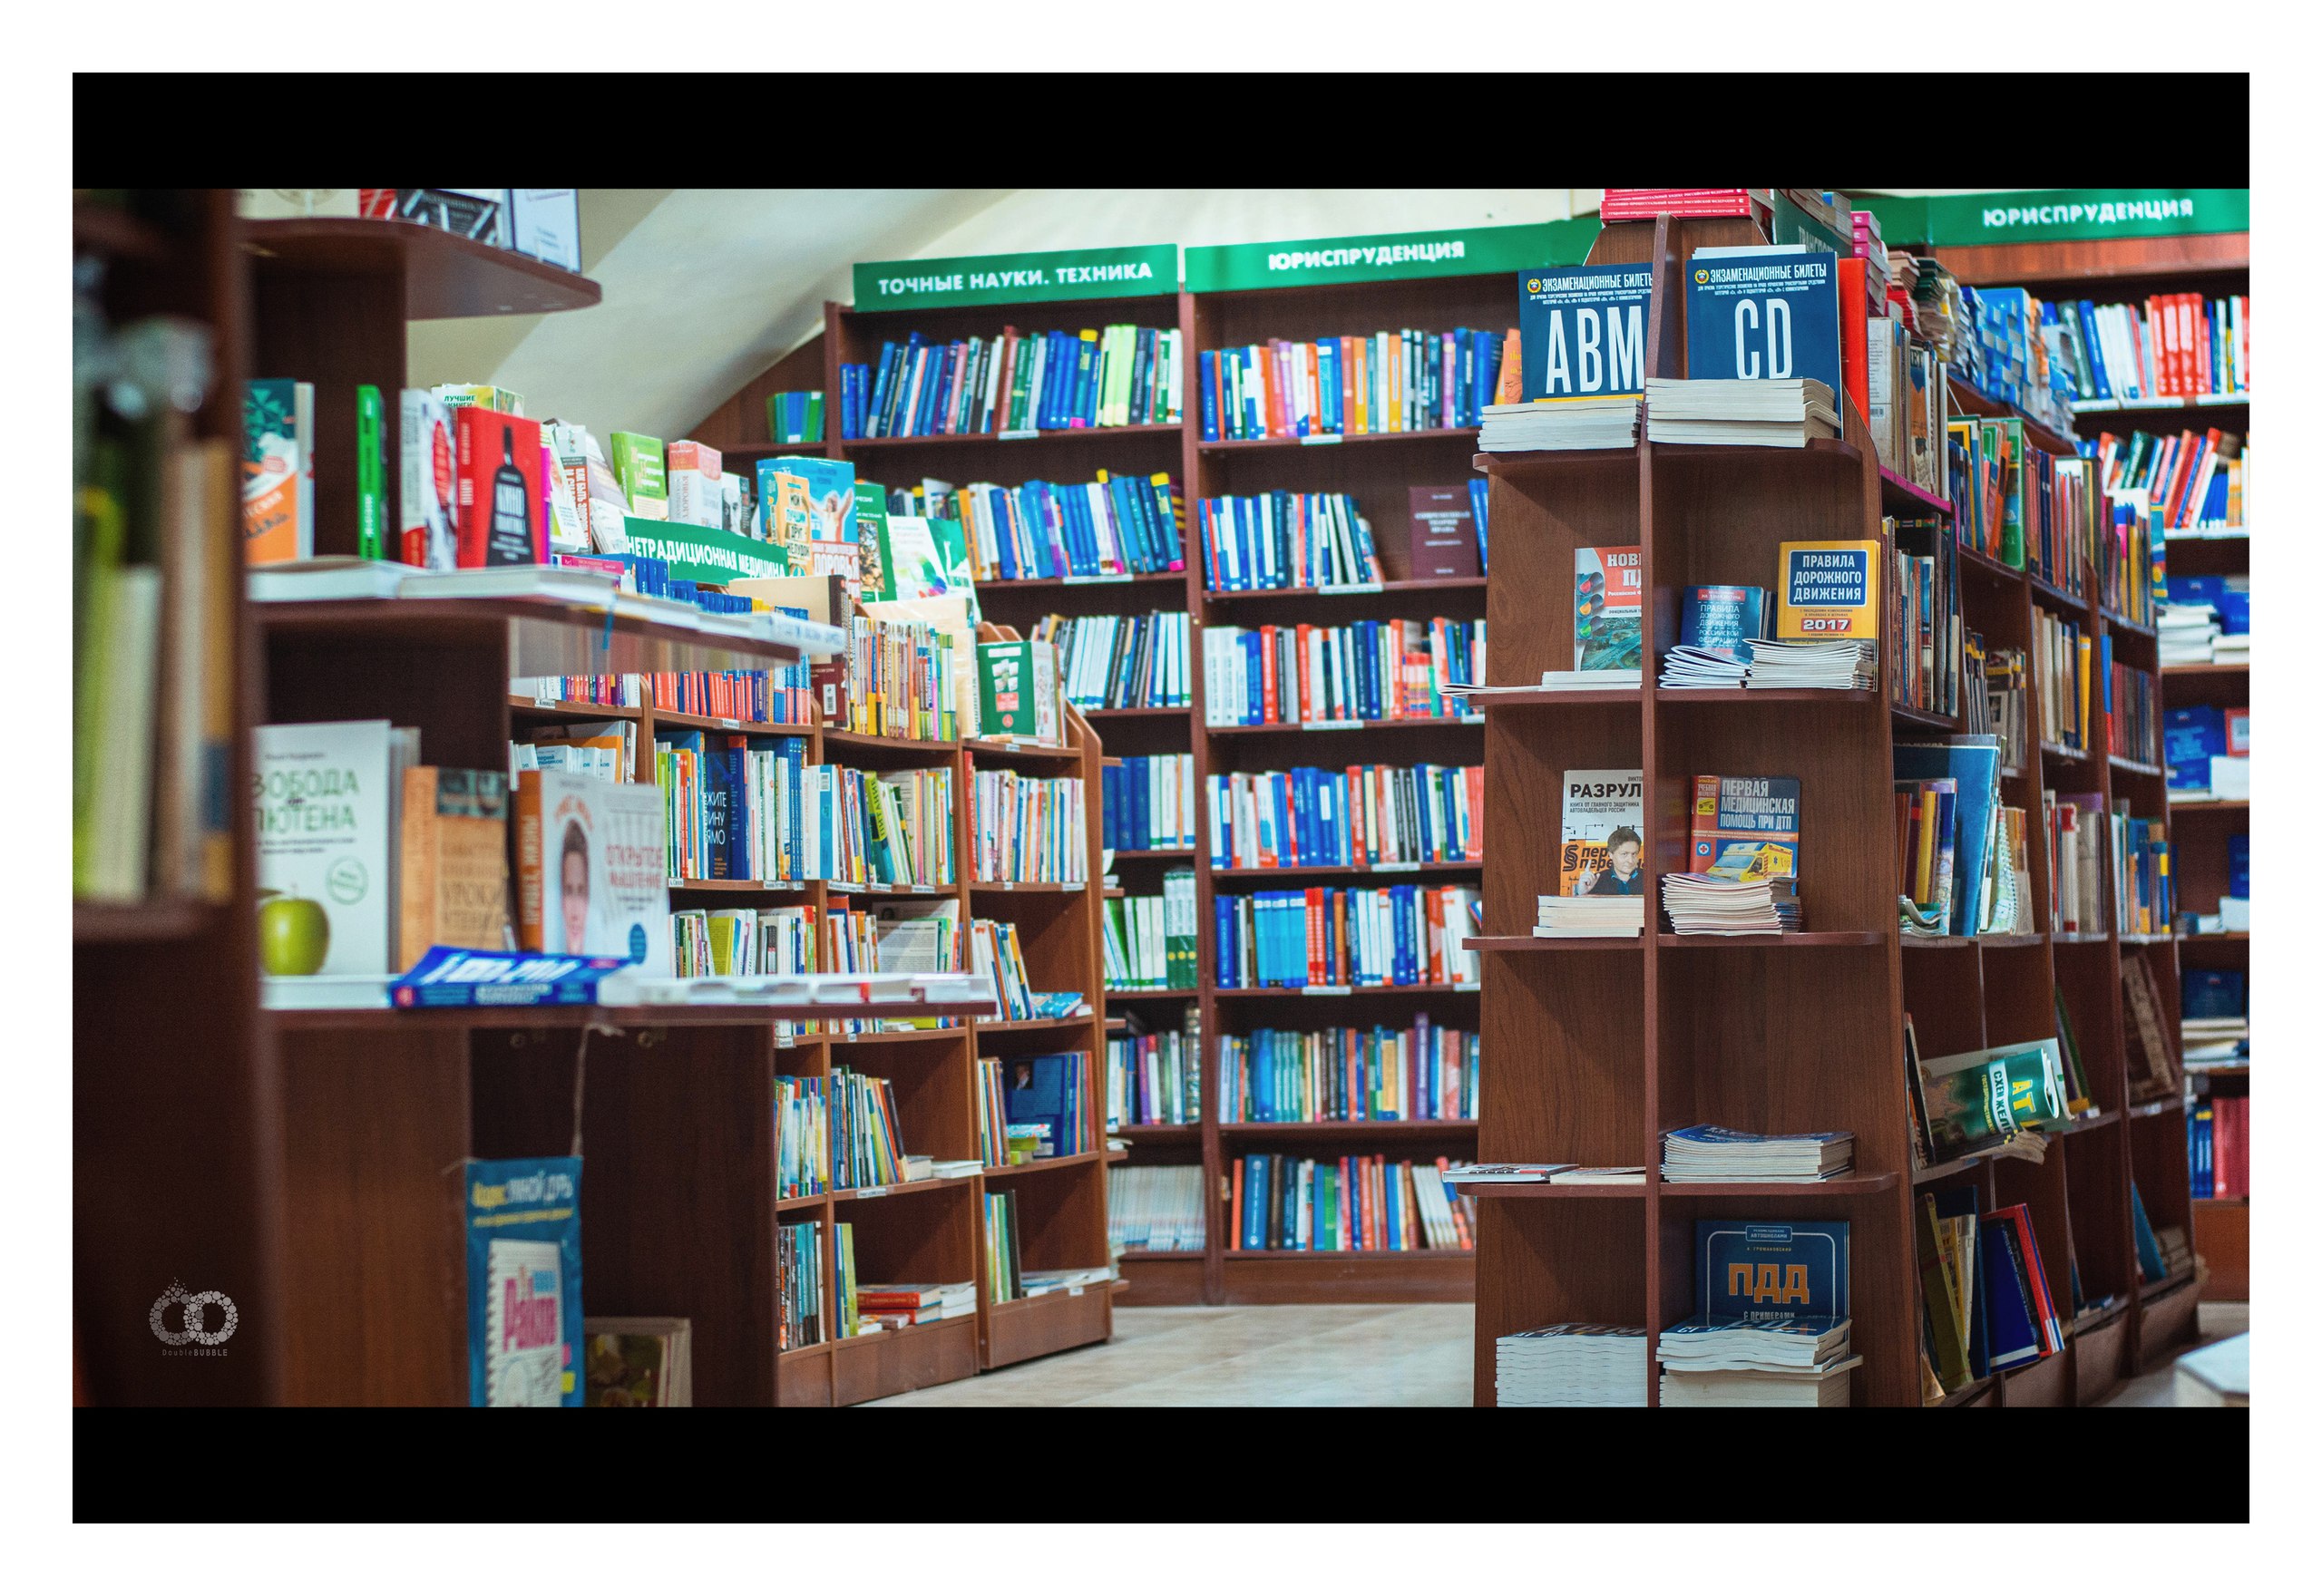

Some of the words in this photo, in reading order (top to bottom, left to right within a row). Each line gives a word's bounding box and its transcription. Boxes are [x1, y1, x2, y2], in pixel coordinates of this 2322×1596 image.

[1982, 199, 2193, 227] ЮРИСПРУДЕНЦИЯ
[1268, 240, 1465, 270] ЮРИСПРУДЕНЦИЯ
[878, 274, 963, 296] ТОЧНЫЕ
[970, 269, 1049, 289] НАУКИ.
[1056, 262, 1153, 284] ТЕХНИКА
[1710, 265, 1791, 283] ЭКЗАМЕНАЦИОННЫЕ
[1793, 263, 1827, 278] БИЛЕТЫ
[1542, 275, 1622, 292] ЭКЗАМЕНАЦИОННЫЕ
[1734, 298, 1793, 379] CD
[626, 535, 737, 571] НЕТРАДИЦИОННАЯ
[738, 553, 786, 579] МЕДИЦИНА
[1802, 555, 1855, 568] ПРАВИЛА
[1793, 570, 1862, 586] ДОРОЖНОГО
[1793, 587, 1861, 602] ДВИЖЕНИЯ
[1700, 604, 1740, 612] ПРАВИЛА
[1699, 628, 1740, 637] РОССИЙСКОЙ
[1803, 619, 1849, 630] 2017
[1570, 783, 1642, 798] РАЗРУЛ
[1722, 779, 1769, 797] ПЕРВАЯ
[1721, 796, 1795, 814] МЕДИЦИНСКАЯ
[1720, 814, 1756, 829] ПОМОЩЬ
[1758, 814, 1774, 829] ПРИ
[1776, 815, 1792, 831] ДТП
[1728, 1262, 1810, 1305] ПДД
[1743, 1310, 1749, 1320] С
[1751, 1310, 1795, 1321] ПРИМЕРАМИ
